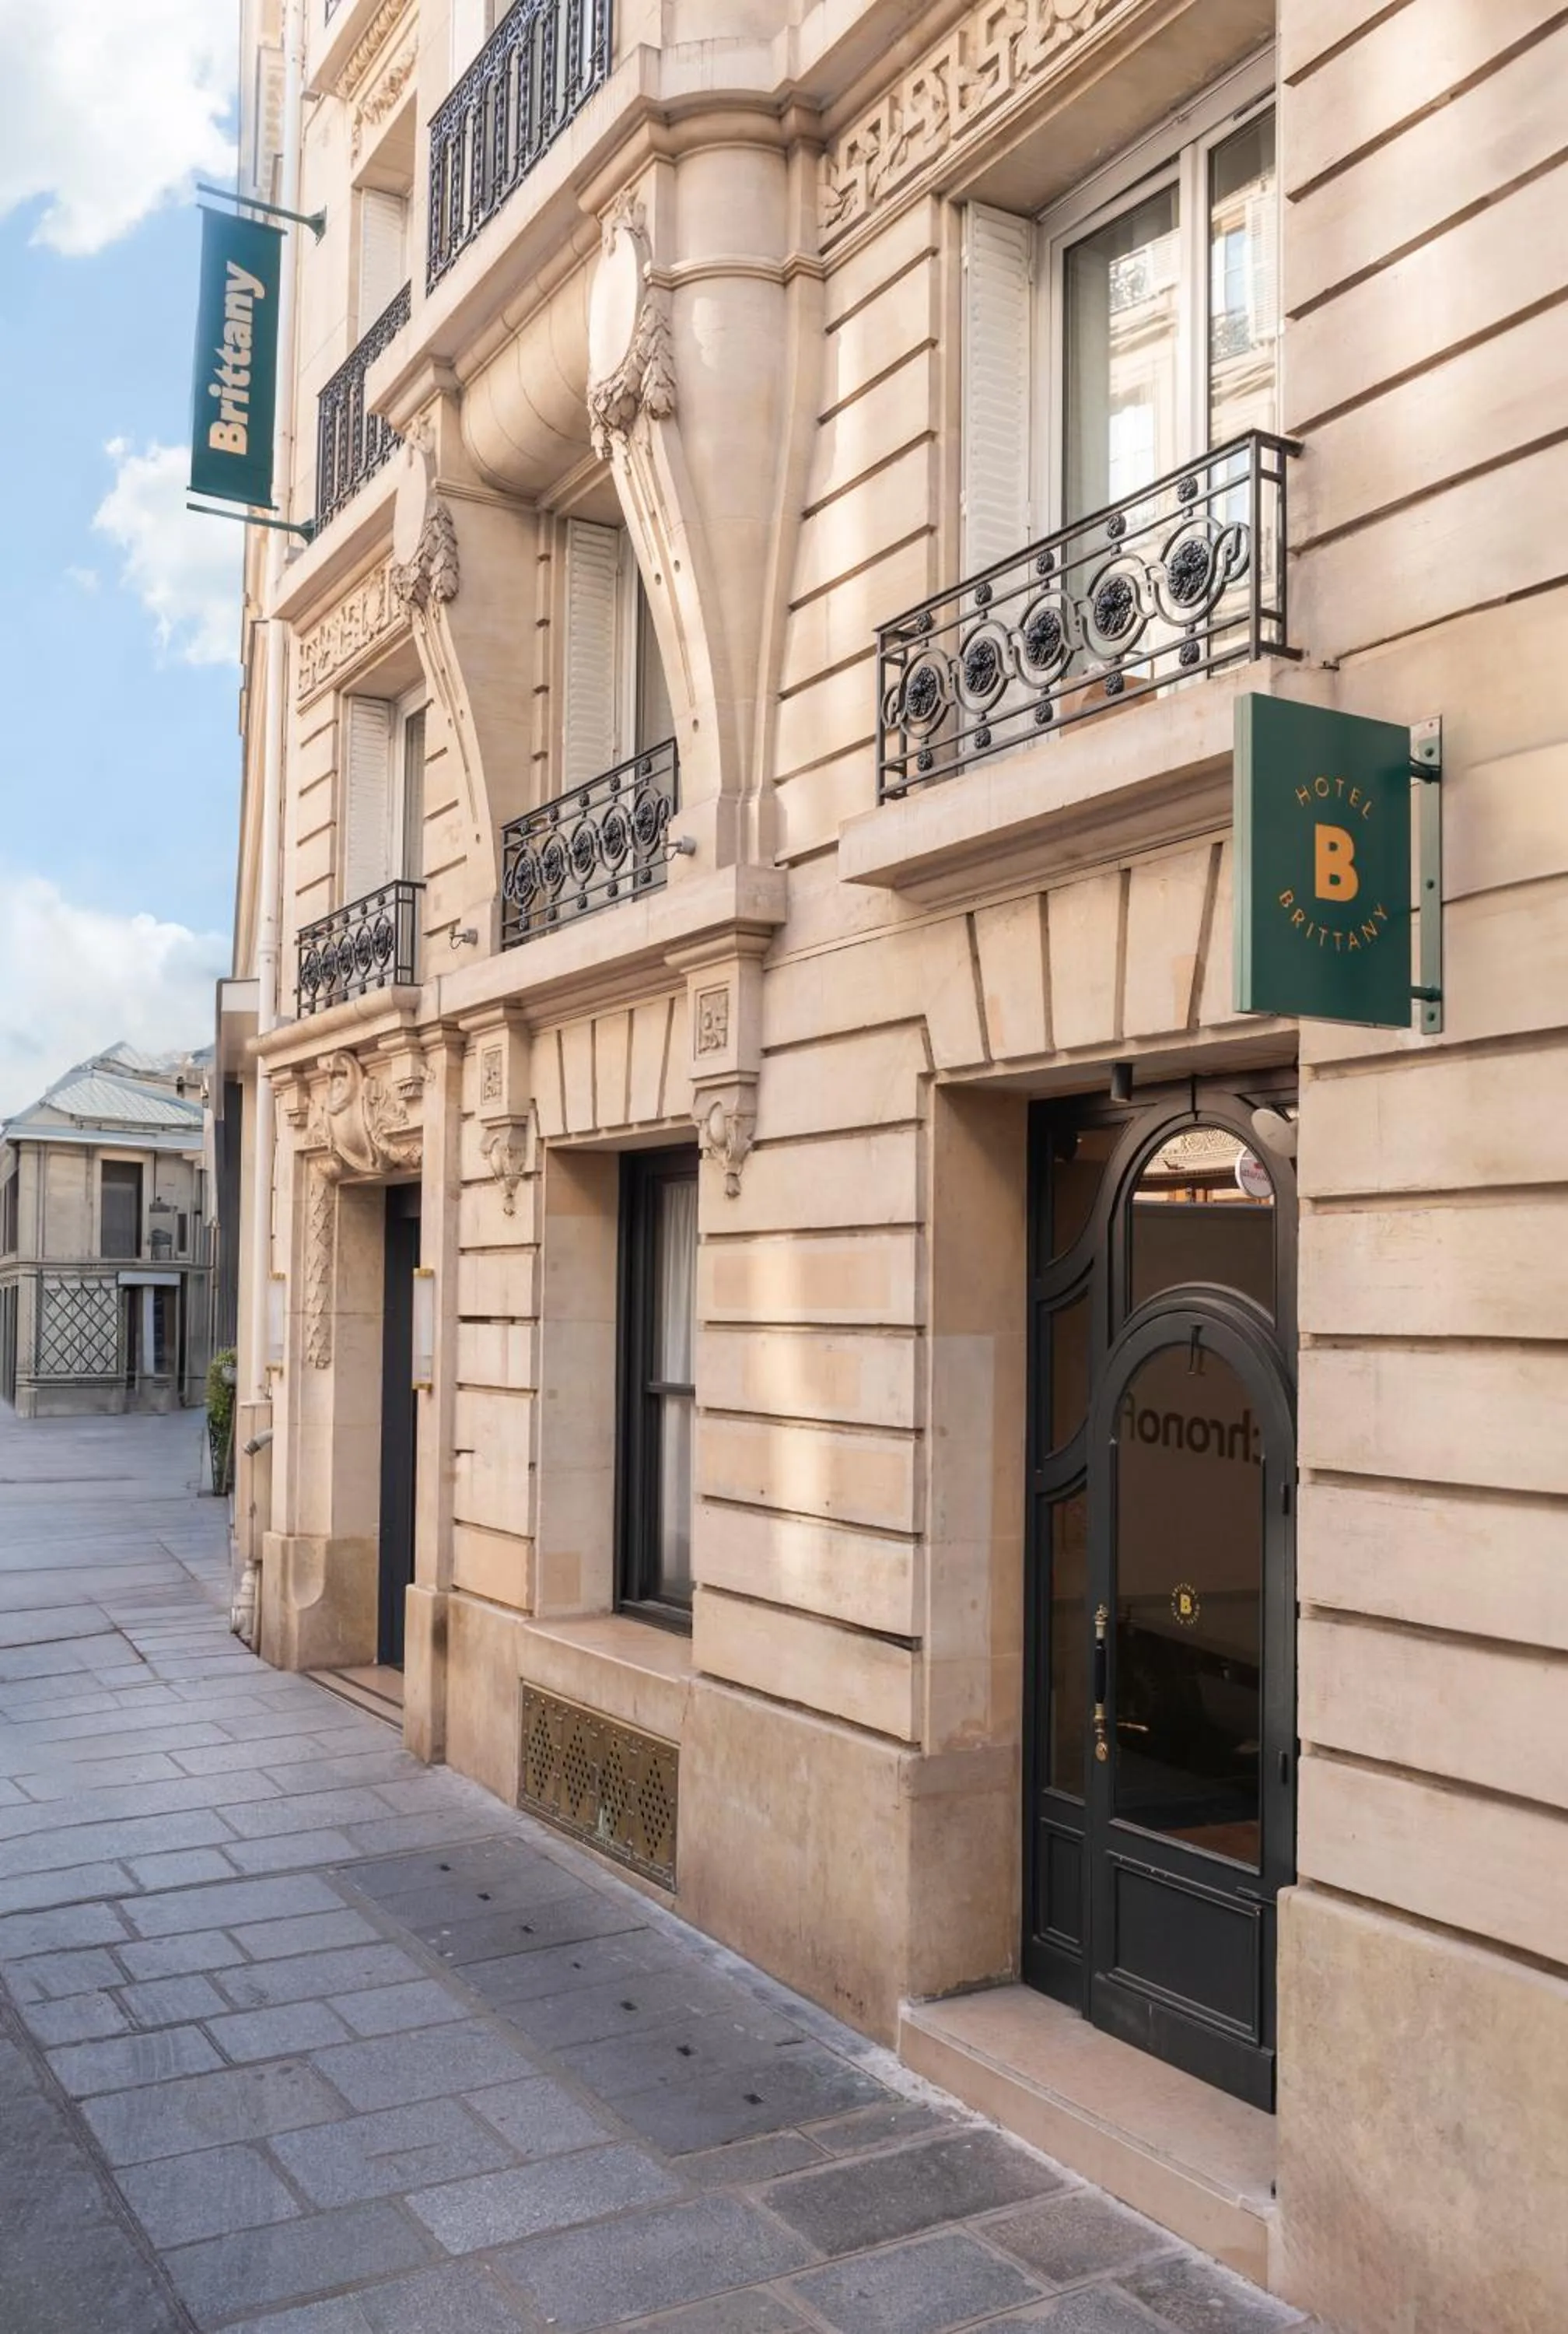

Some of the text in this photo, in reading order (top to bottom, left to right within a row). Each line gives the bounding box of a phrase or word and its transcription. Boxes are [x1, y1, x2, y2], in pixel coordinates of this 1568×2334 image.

[208, 260, 265, 455] Brittany
[1295, 777, 1374, 819] HOTEL
[1314, 823, 1358, 902] B
[1279, 890, 1388, 951] BRITTANY
[1180, 1593, 1192, 1614] B
